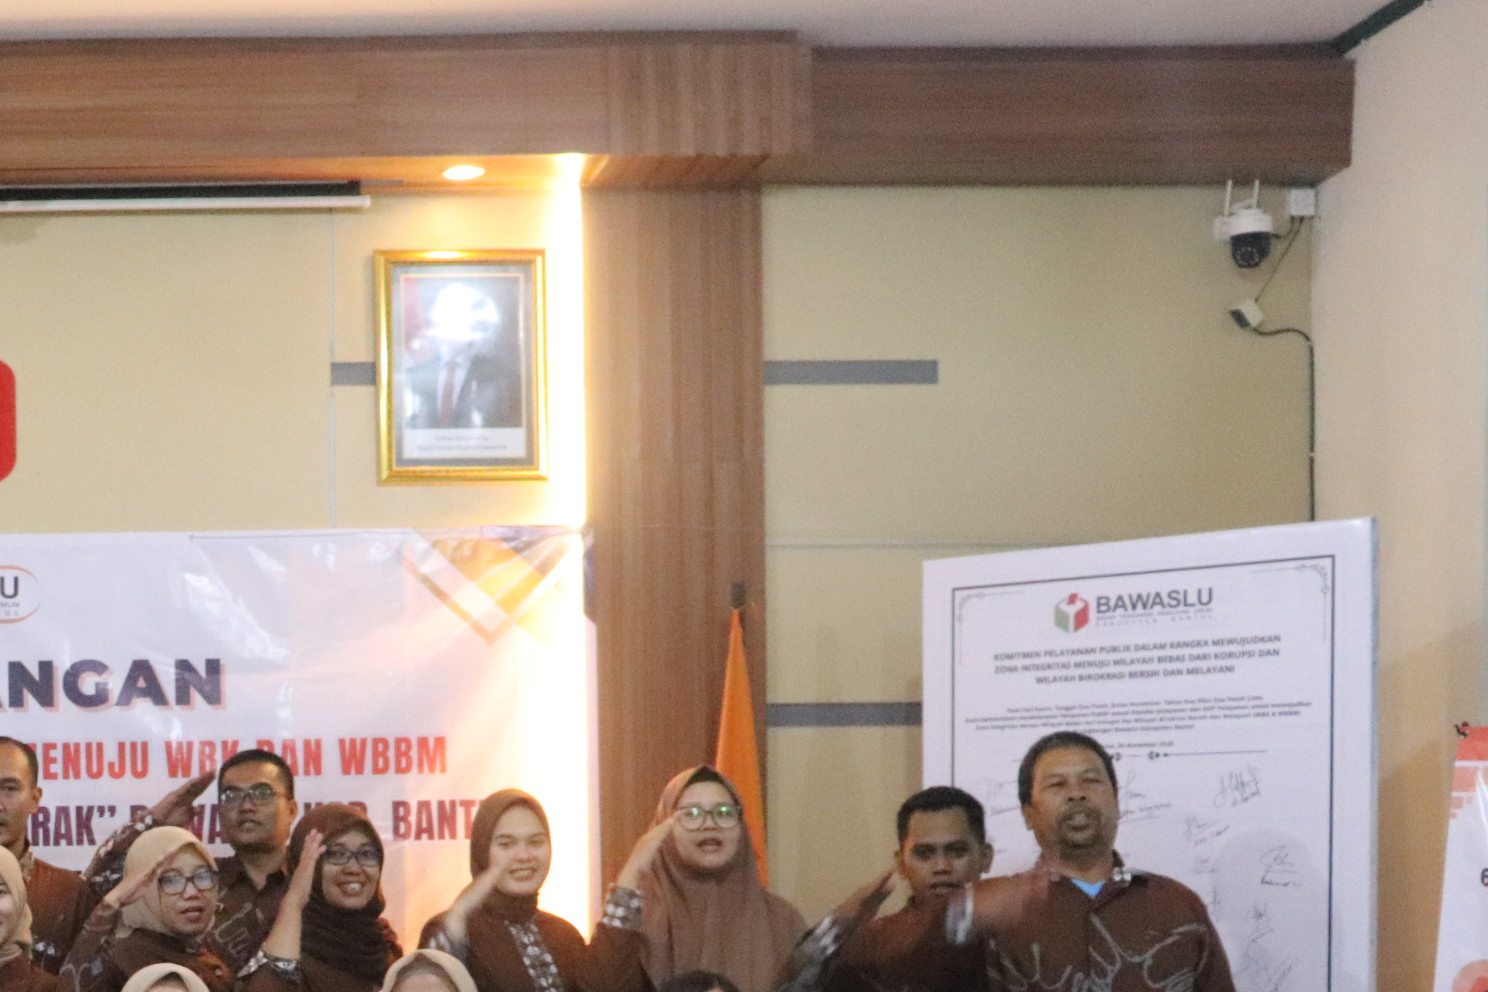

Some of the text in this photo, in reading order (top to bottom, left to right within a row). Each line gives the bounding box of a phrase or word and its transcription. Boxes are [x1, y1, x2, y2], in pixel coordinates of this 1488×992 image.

[1096, 587, 1214, 615] BAWASLU
[1043, 647, 1097, 658] PELAYANAN
[1099, 643, 1131, 654] PUBLIK
[1133, 641, 1167, 652] DALAM
[1258, 648, 1281, 658] DAN
[1162, 667, 1184, 677] DAN
[28, 741, 150, 780] ENUJU
[338, 736, 447, 776] WBBM
[391, 800, 483, 842] BANT
